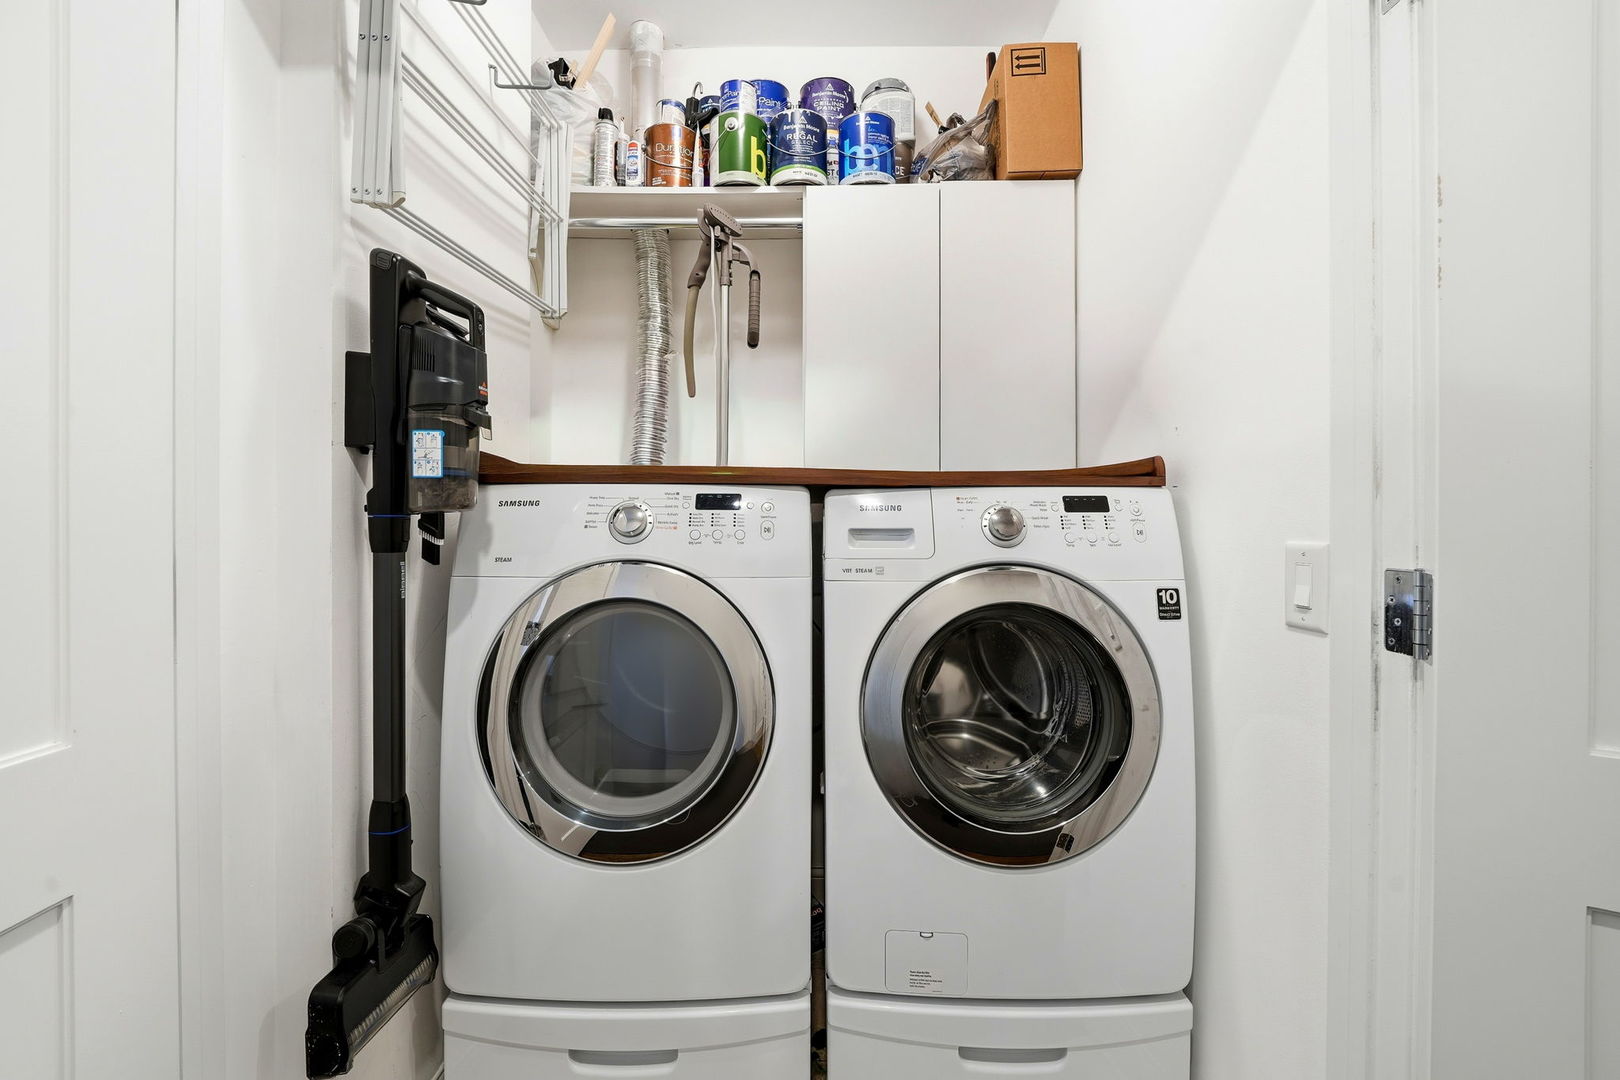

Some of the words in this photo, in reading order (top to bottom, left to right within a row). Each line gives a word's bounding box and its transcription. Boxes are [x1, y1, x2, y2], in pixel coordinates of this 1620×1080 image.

[813, 101, 845, 109] CEILING
[786, 133, 818, 143] REGAL
[859, 504, 902, 512] SAMSUNG
[1158, 590, 1178, 604] 10
